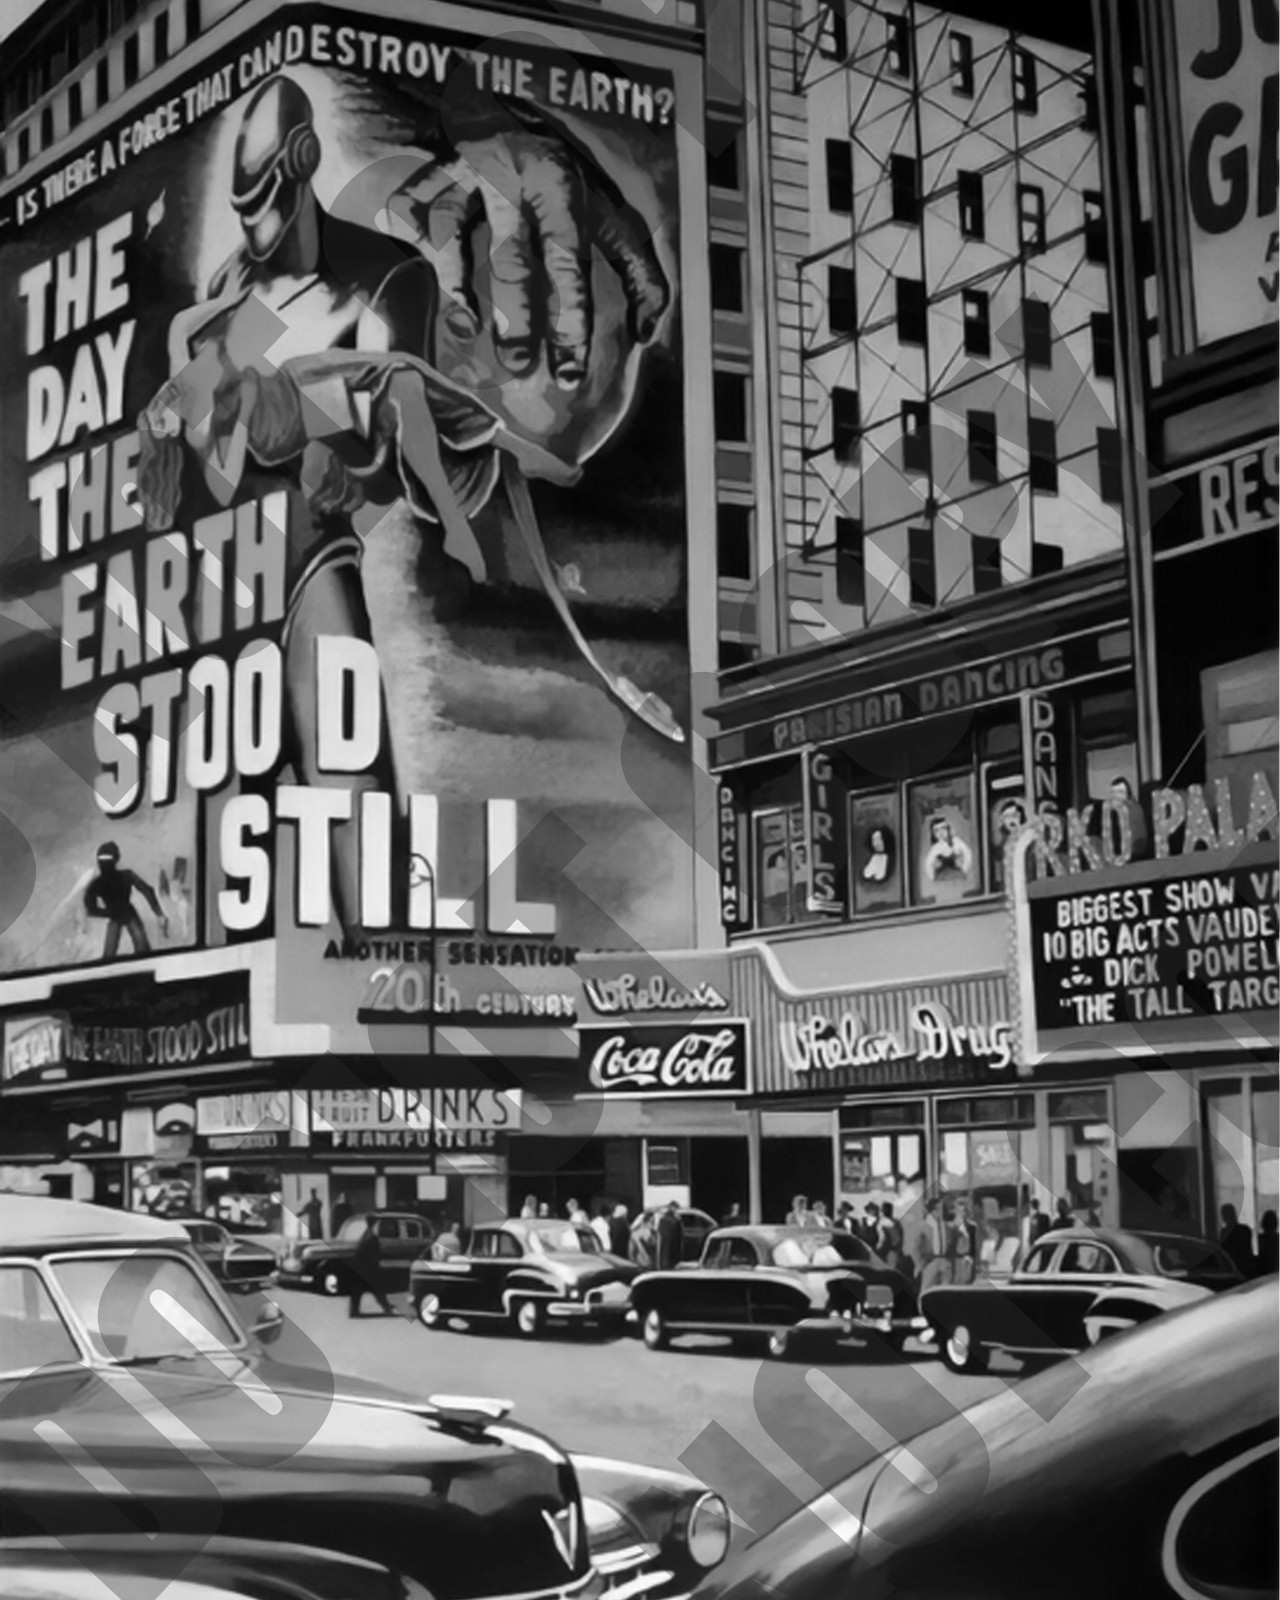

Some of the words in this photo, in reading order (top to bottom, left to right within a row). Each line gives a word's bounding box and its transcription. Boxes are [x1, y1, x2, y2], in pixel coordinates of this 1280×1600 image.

[16, 188, 38, 226] IS
[100, 140, 116, 176] A
[119, 98, 181, 165] FORCE
[183, 63, 234, 123] THAT
[239, 31, 281, 88] CAN
[285, 24, 450, 82] DESTROY
[469, 51, 535, 99] THE
[550, 67, 675, 124] EARTH?
[19, 212, 133, 355] THE
[26, 319, 137, 462] DAY
[28, 430, 144, 560] THE
[61, 490, 287, 690] EARTH
[920, 648, 1064, 714] DANCING
[93, 634, 381, 814] STOOD
[811, 753, 836, 900] GIRLS
[1036, 800, 1132, 879] RKO
[1152, 770, 1278, 859] PALA
[218, 786, 557, 934] STILL
[1058, 889, 1152, 928] BIGGEST
[1165, 877, 1235, 912] SHOW
[1070, 926, 1110, 959] BIG
[1117, 917, 1180, 954] ACTS
[1186, 903, 1278, 944] VAUDE
[323, 939, 433, 962] ANOTHER
[448, 941, 578, 966] SENSATION
[1105, 954, 1160, 986] DICK
[1128, 985, 1193, 1020] TALL
[1208, 976, 1278, 1011] TARG
[147, 1020, 203, 1064] STOOD
[589, 1036, 660, 1088] Coca
[660, 1029, 737, 1085] Cola
[912, 1003, 1012, 1068] Drug
[378, 1088, 508, 1125] DRINKS
